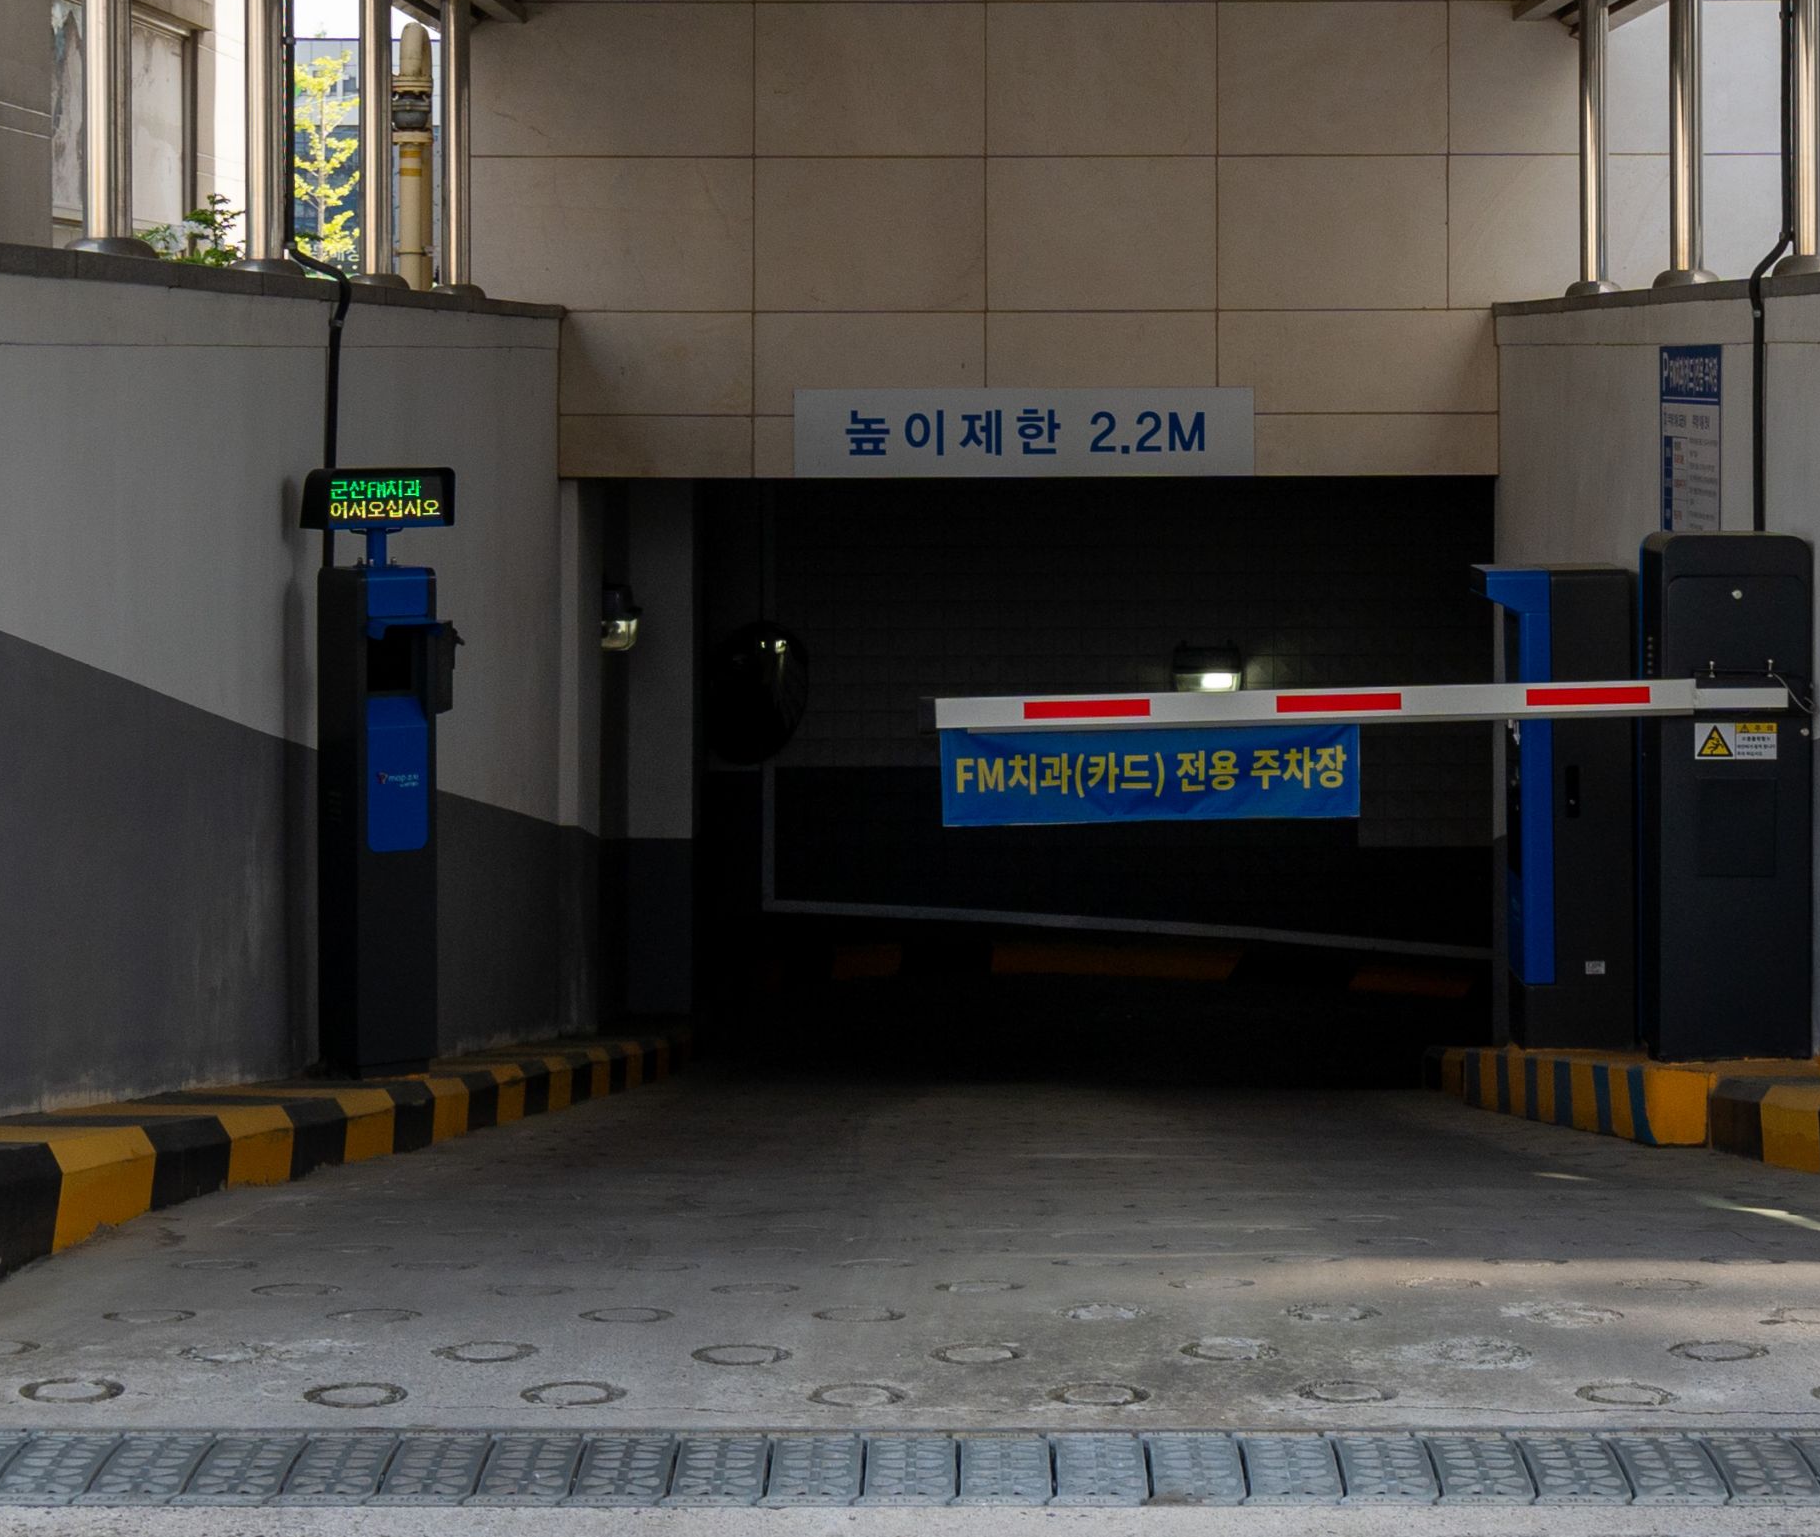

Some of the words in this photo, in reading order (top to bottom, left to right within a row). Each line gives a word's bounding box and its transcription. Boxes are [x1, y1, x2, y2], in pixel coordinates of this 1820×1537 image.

[845, 407, 1061, 456] 높이제한
[1089, 411, 1207, 453] 2.2M
[330, 498, 441, 519] 어서오십시오
[956, 752, 1166, 798] FM치과(카드)
[1176, 750, 1240, 791] 전용
[1250, 745, 1348, 788] 주차장
